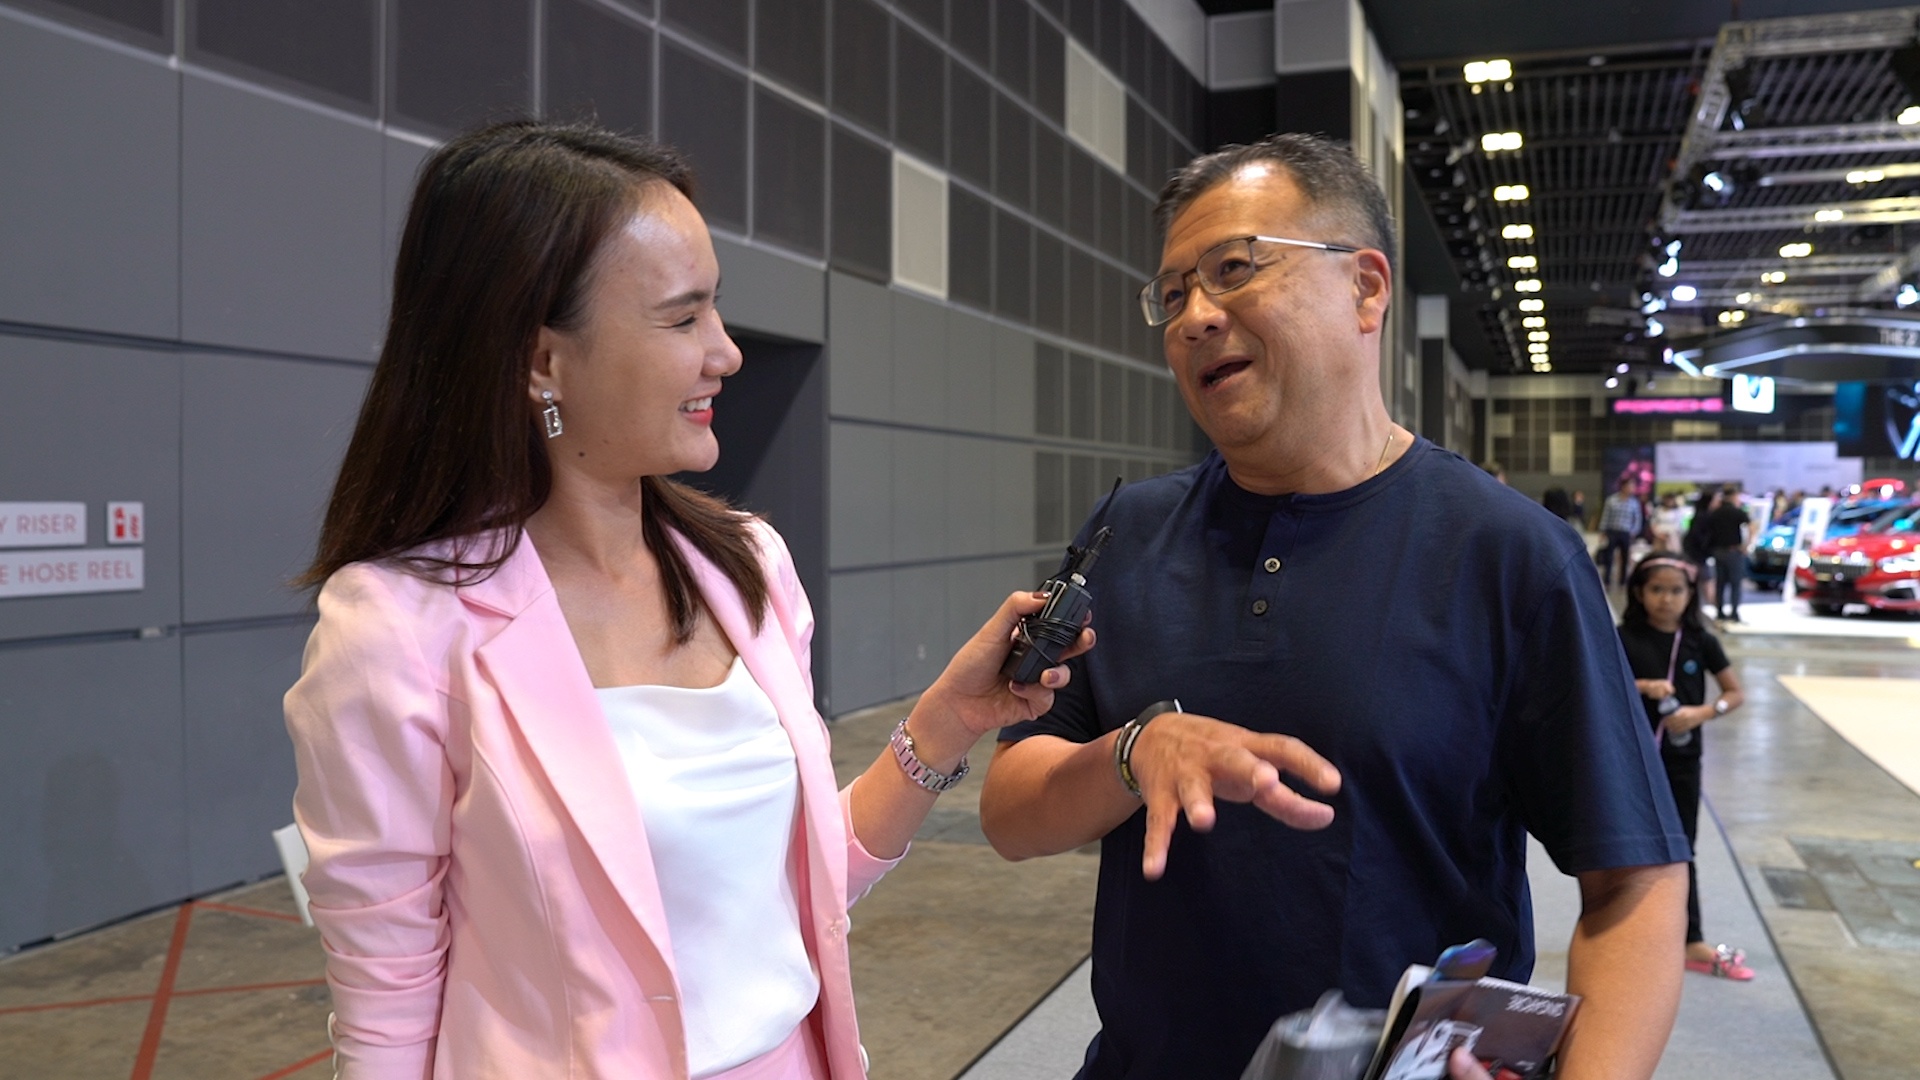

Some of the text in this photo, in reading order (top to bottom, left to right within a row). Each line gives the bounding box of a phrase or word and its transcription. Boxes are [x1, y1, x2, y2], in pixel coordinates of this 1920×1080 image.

[16, 513, 77, 535] RISER
[18, 561, 79, 584] HOSE
[87, 559, 134, 581] REEL
